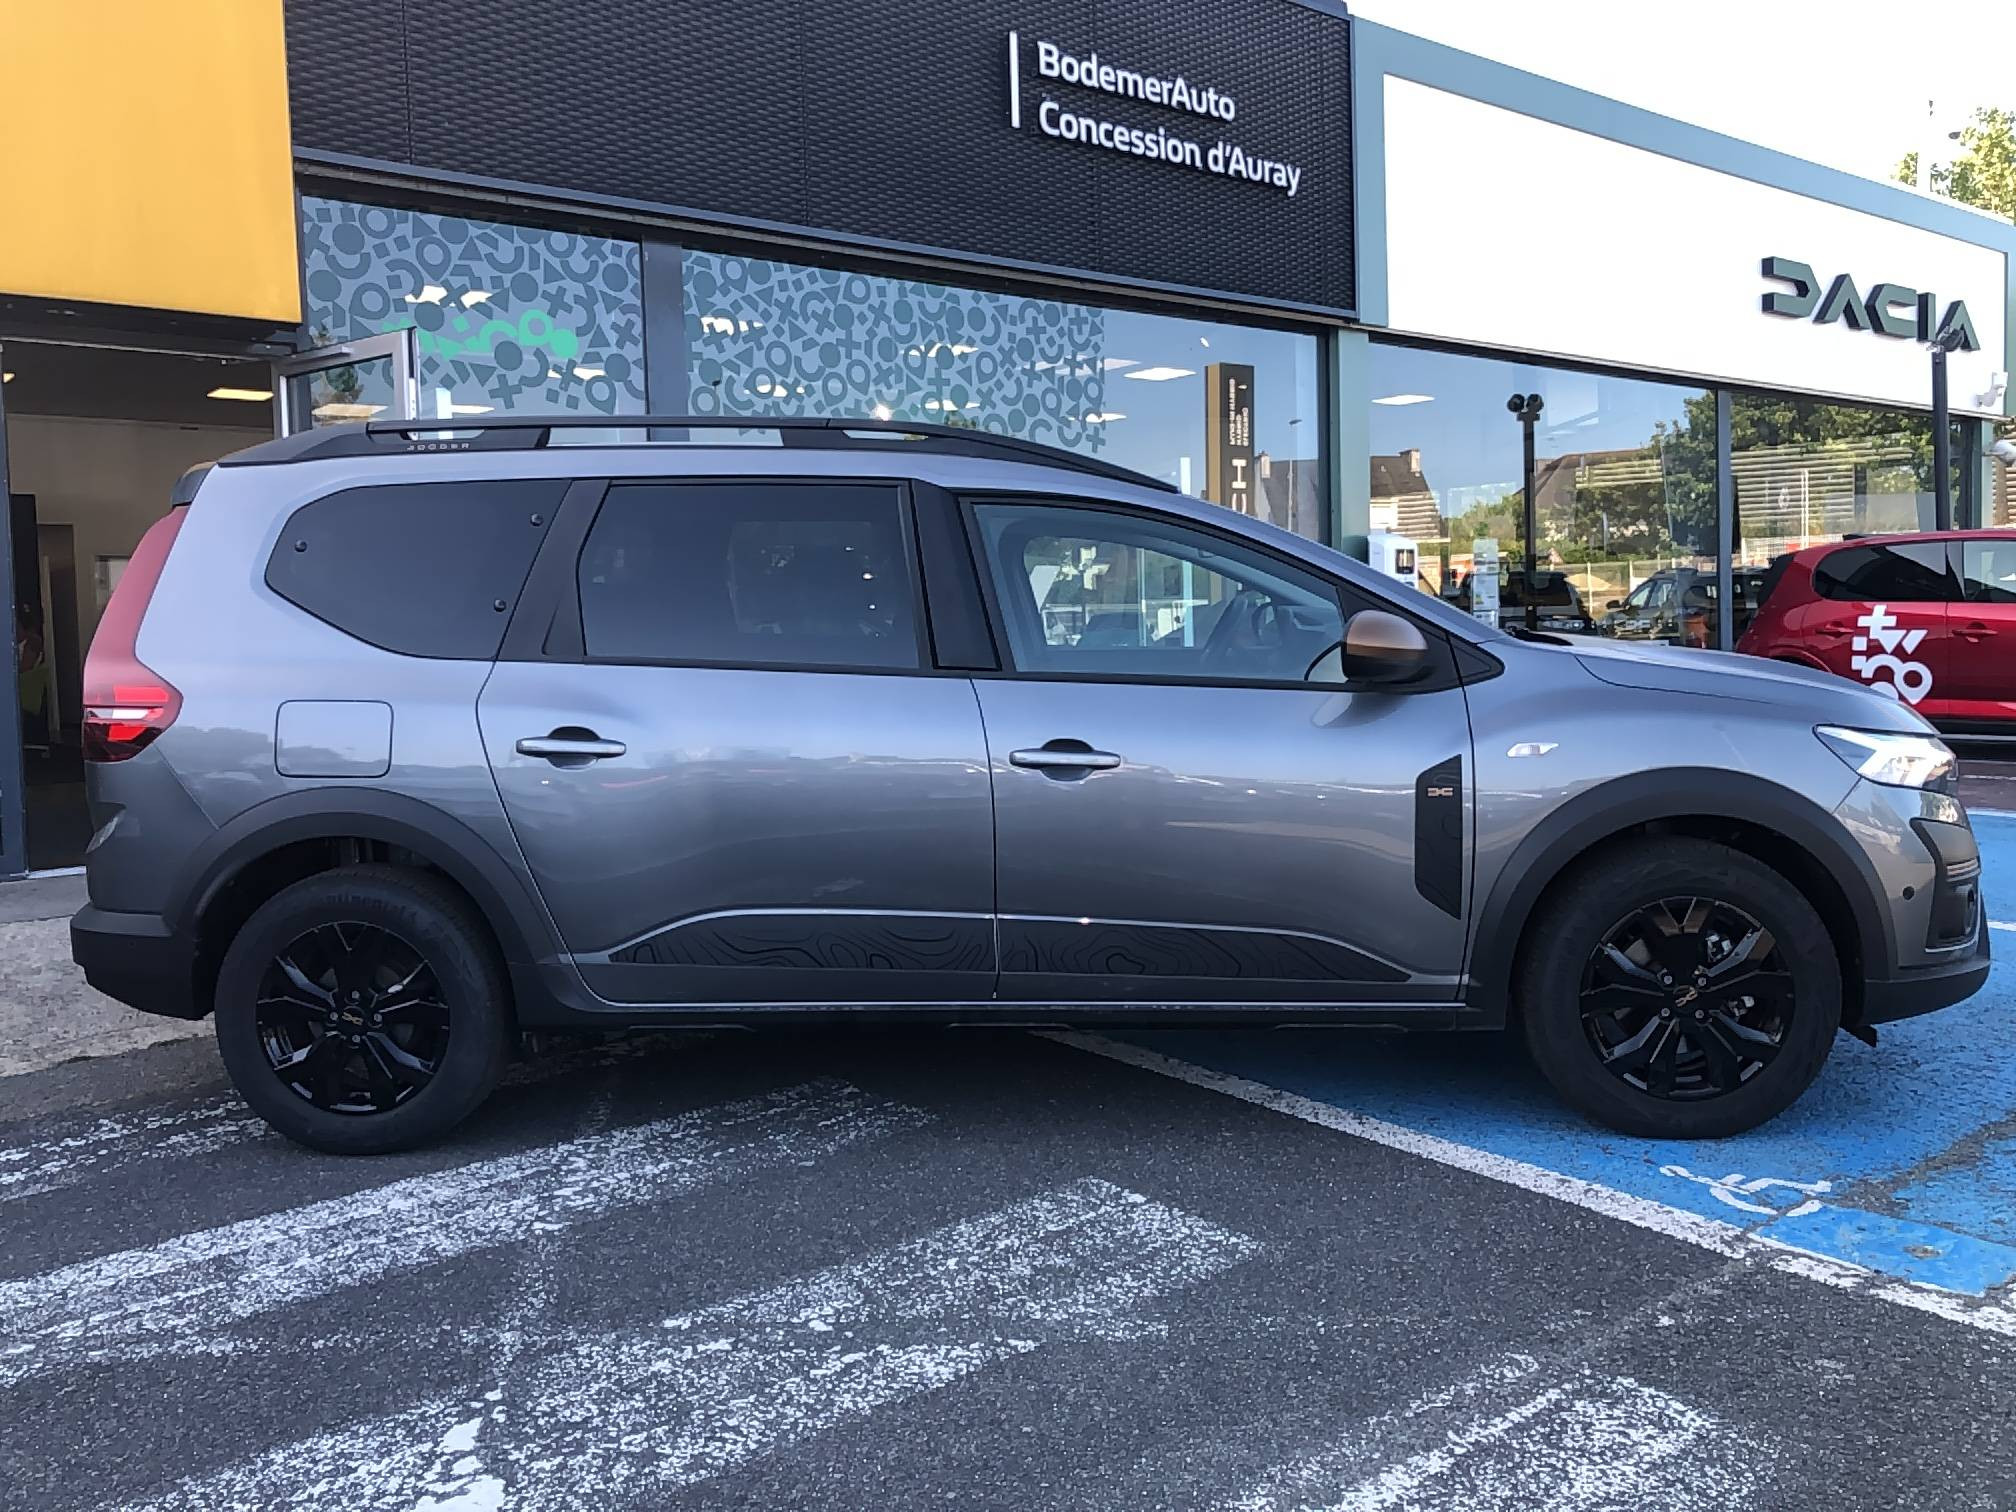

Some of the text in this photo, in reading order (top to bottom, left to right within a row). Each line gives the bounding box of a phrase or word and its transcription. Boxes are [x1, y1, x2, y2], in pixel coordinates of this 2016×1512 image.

[1037, 41, 1236, 121] BodemerAuto
[1039, 101, 1301, 197] Concession d'Auray
[1761, 256, 1981, 351] DACIA
